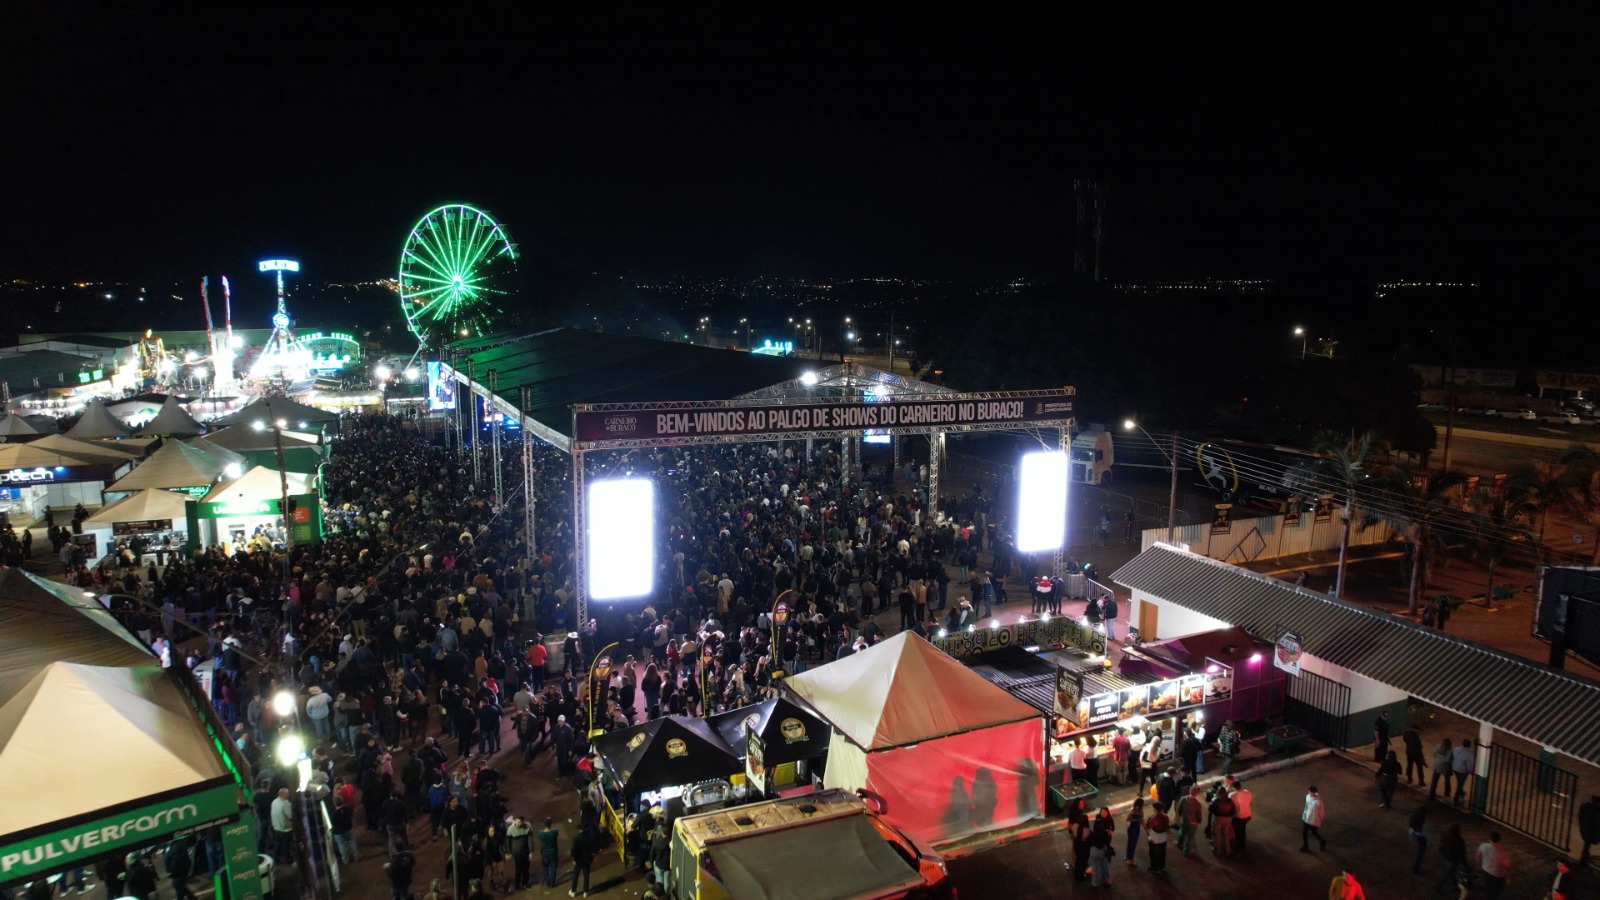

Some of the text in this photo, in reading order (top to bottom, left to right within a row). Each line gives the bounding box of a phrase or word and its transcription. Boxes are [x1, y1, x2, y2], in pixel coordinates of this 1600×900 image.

[604, 417, 637, 425] CARNEIRO
[656, 401, 1024, 434] BEM-VINDOS AO PALCO DE SHOWS DO CARNEIRO NO BURACO!
